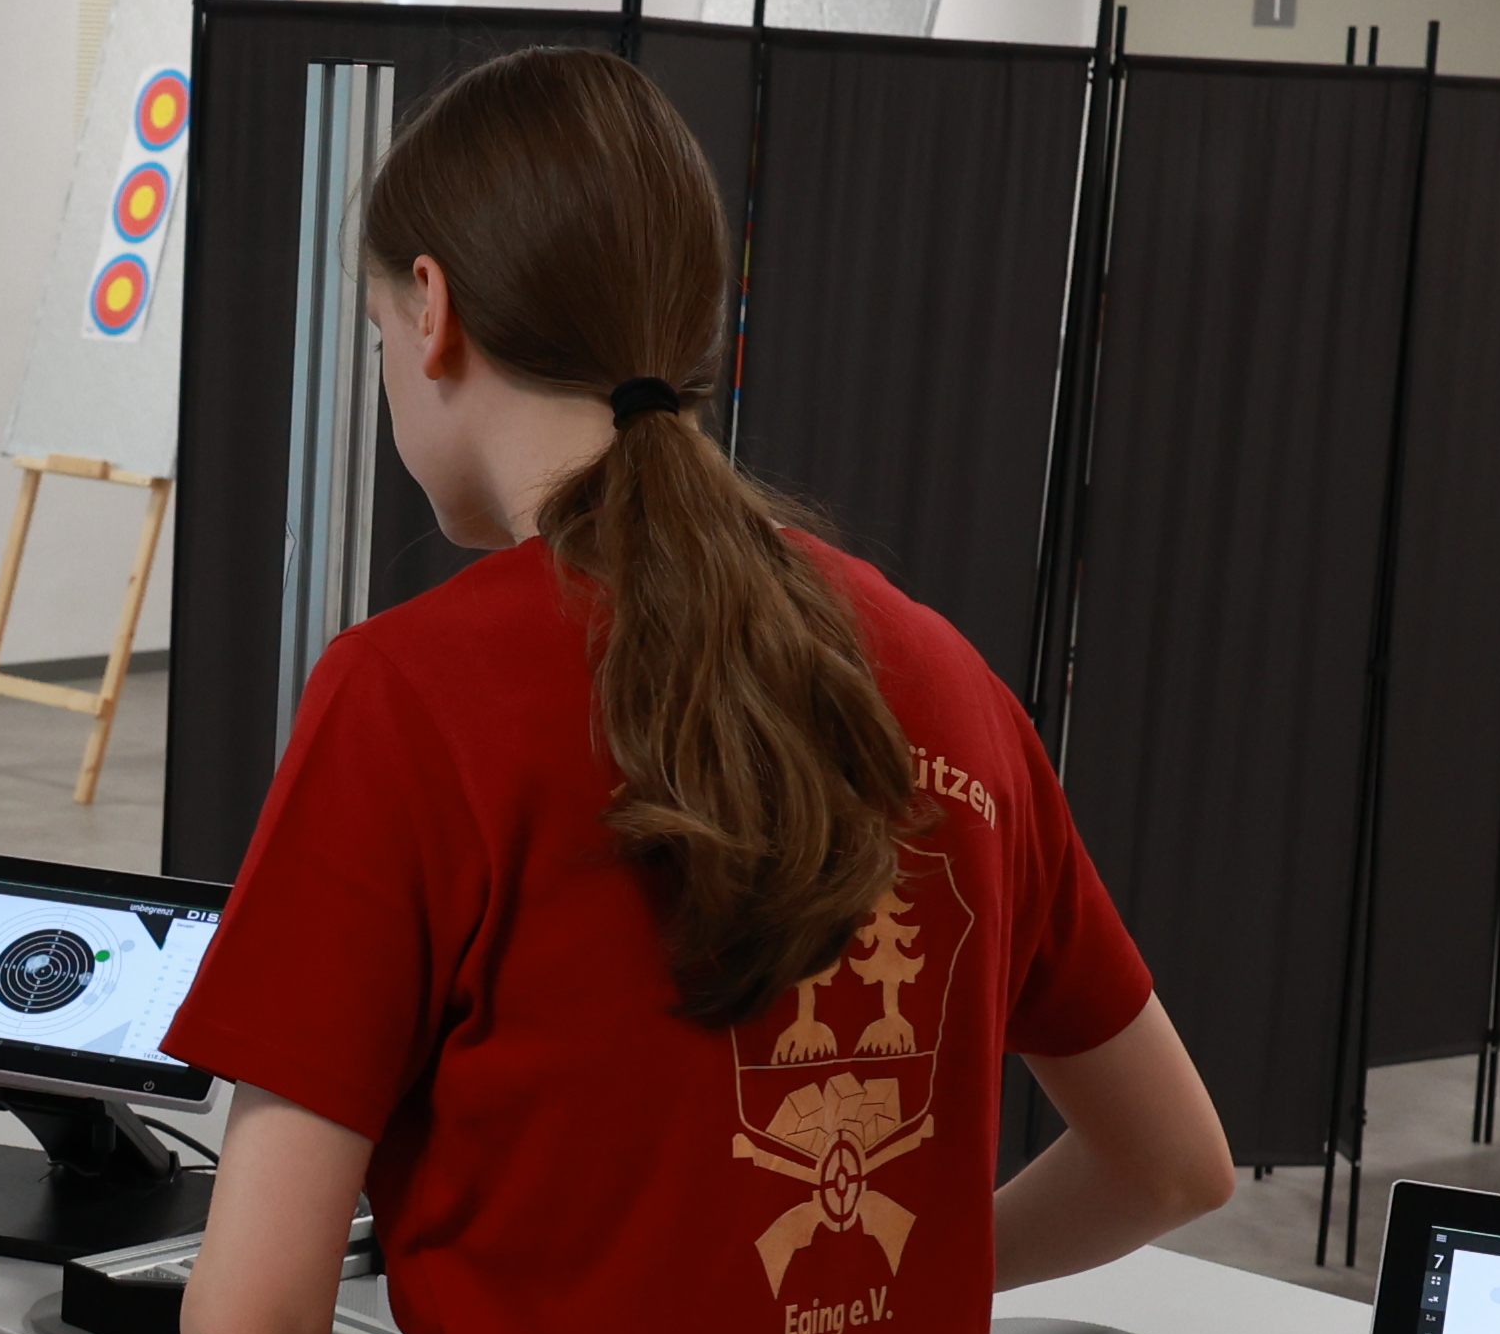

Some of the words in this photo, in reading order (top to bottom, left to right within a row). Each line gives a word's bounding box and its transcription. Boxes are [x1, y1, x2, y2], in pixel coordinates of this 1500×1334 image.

[129, 904, 175, 916] unbegrenzt
[187, 910, 221, 923] DIS
[1434, 1254, 1445, 1269] 7
[849, 1285, 893, 1326] e.V.
